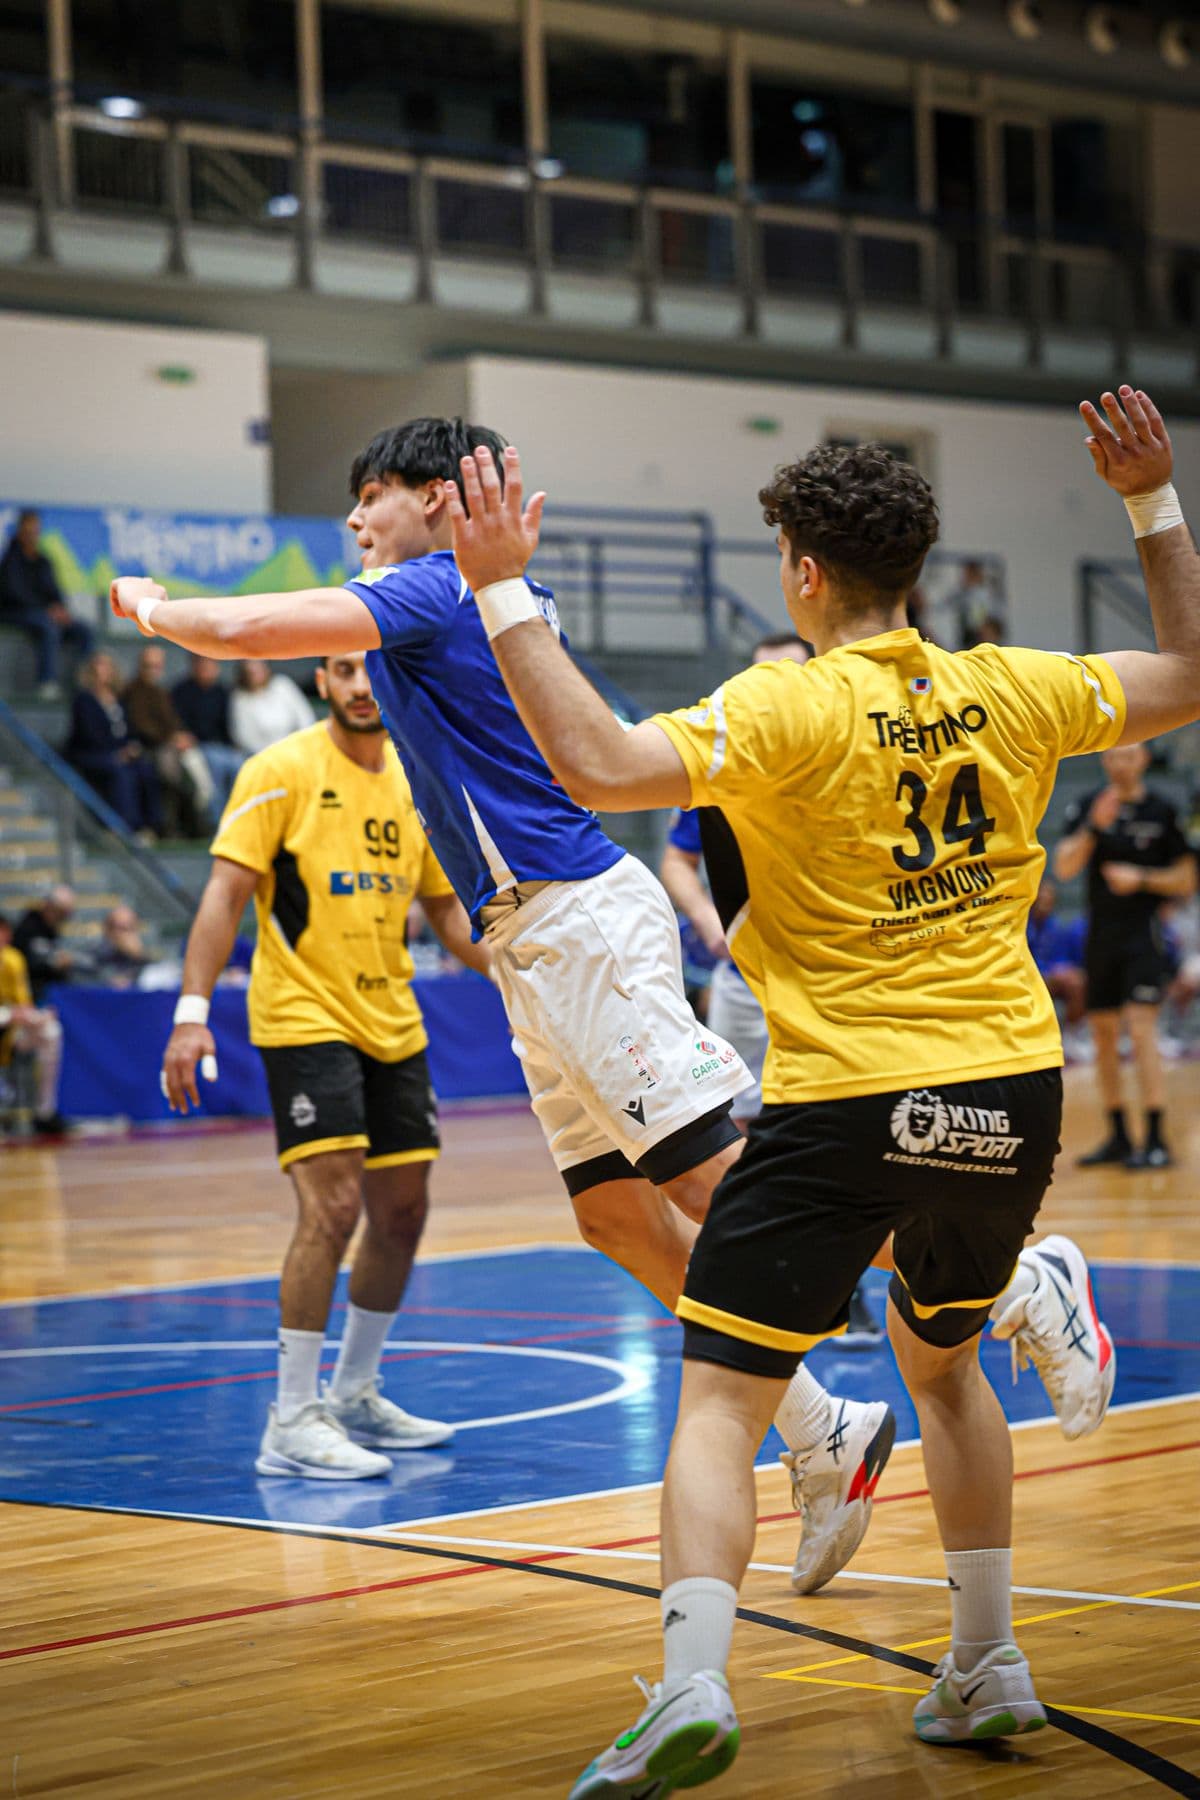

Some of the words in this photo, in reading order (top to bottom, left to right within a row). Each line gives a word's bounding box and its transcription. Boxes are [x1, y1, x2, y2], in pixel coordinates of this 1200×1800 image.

[892, 763, 996, 872] 34
[364, 818, 400, 859] 99
[888, 860, 996, 912] VAGNONI
[947, 1104, 1010, 1134] KING
[938, 1131, 1024, 1160] SPORT
